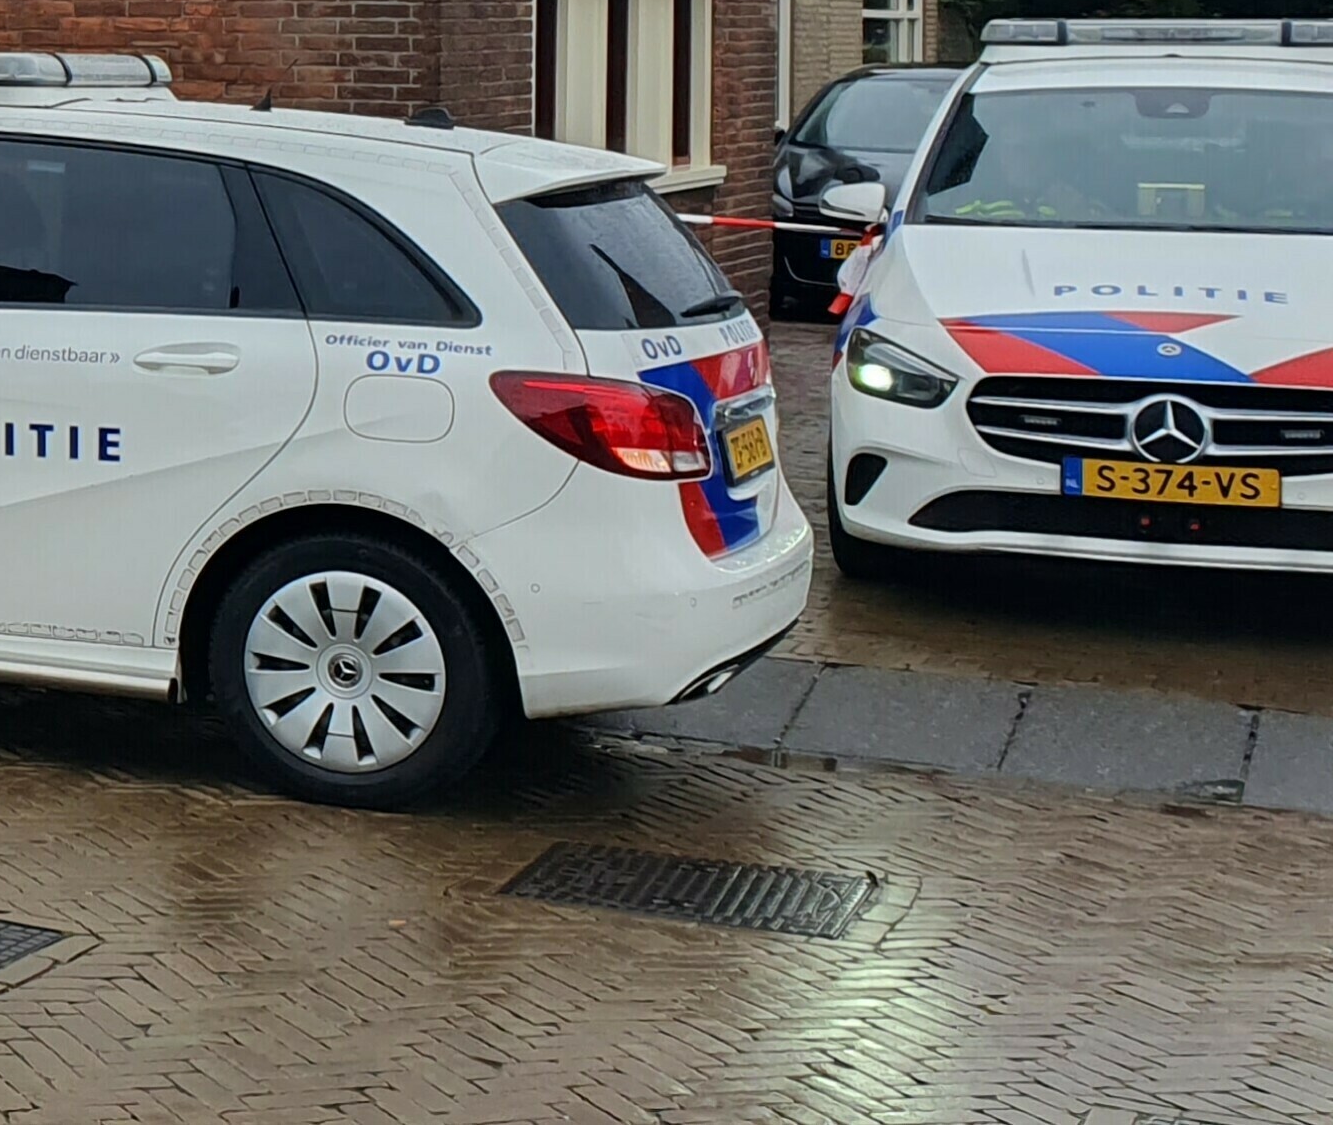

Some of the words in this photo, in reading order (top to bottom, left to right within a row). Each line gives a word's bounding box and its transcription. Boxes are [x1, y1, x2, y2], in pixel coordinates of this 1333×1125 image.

[1054, 285, 1289, 304] POLITIE
[14, 344, 107, 363] dienstbaar
[325, 334, 390, 348] Officier
[397, 340, 428, 351] van
[435, 341, 493, 357] Dienst
[641, 335, 682, 360] OvD
[366, 350, 441, 375] OvD
[1095, 465, 1262, 500] S-374-VS
